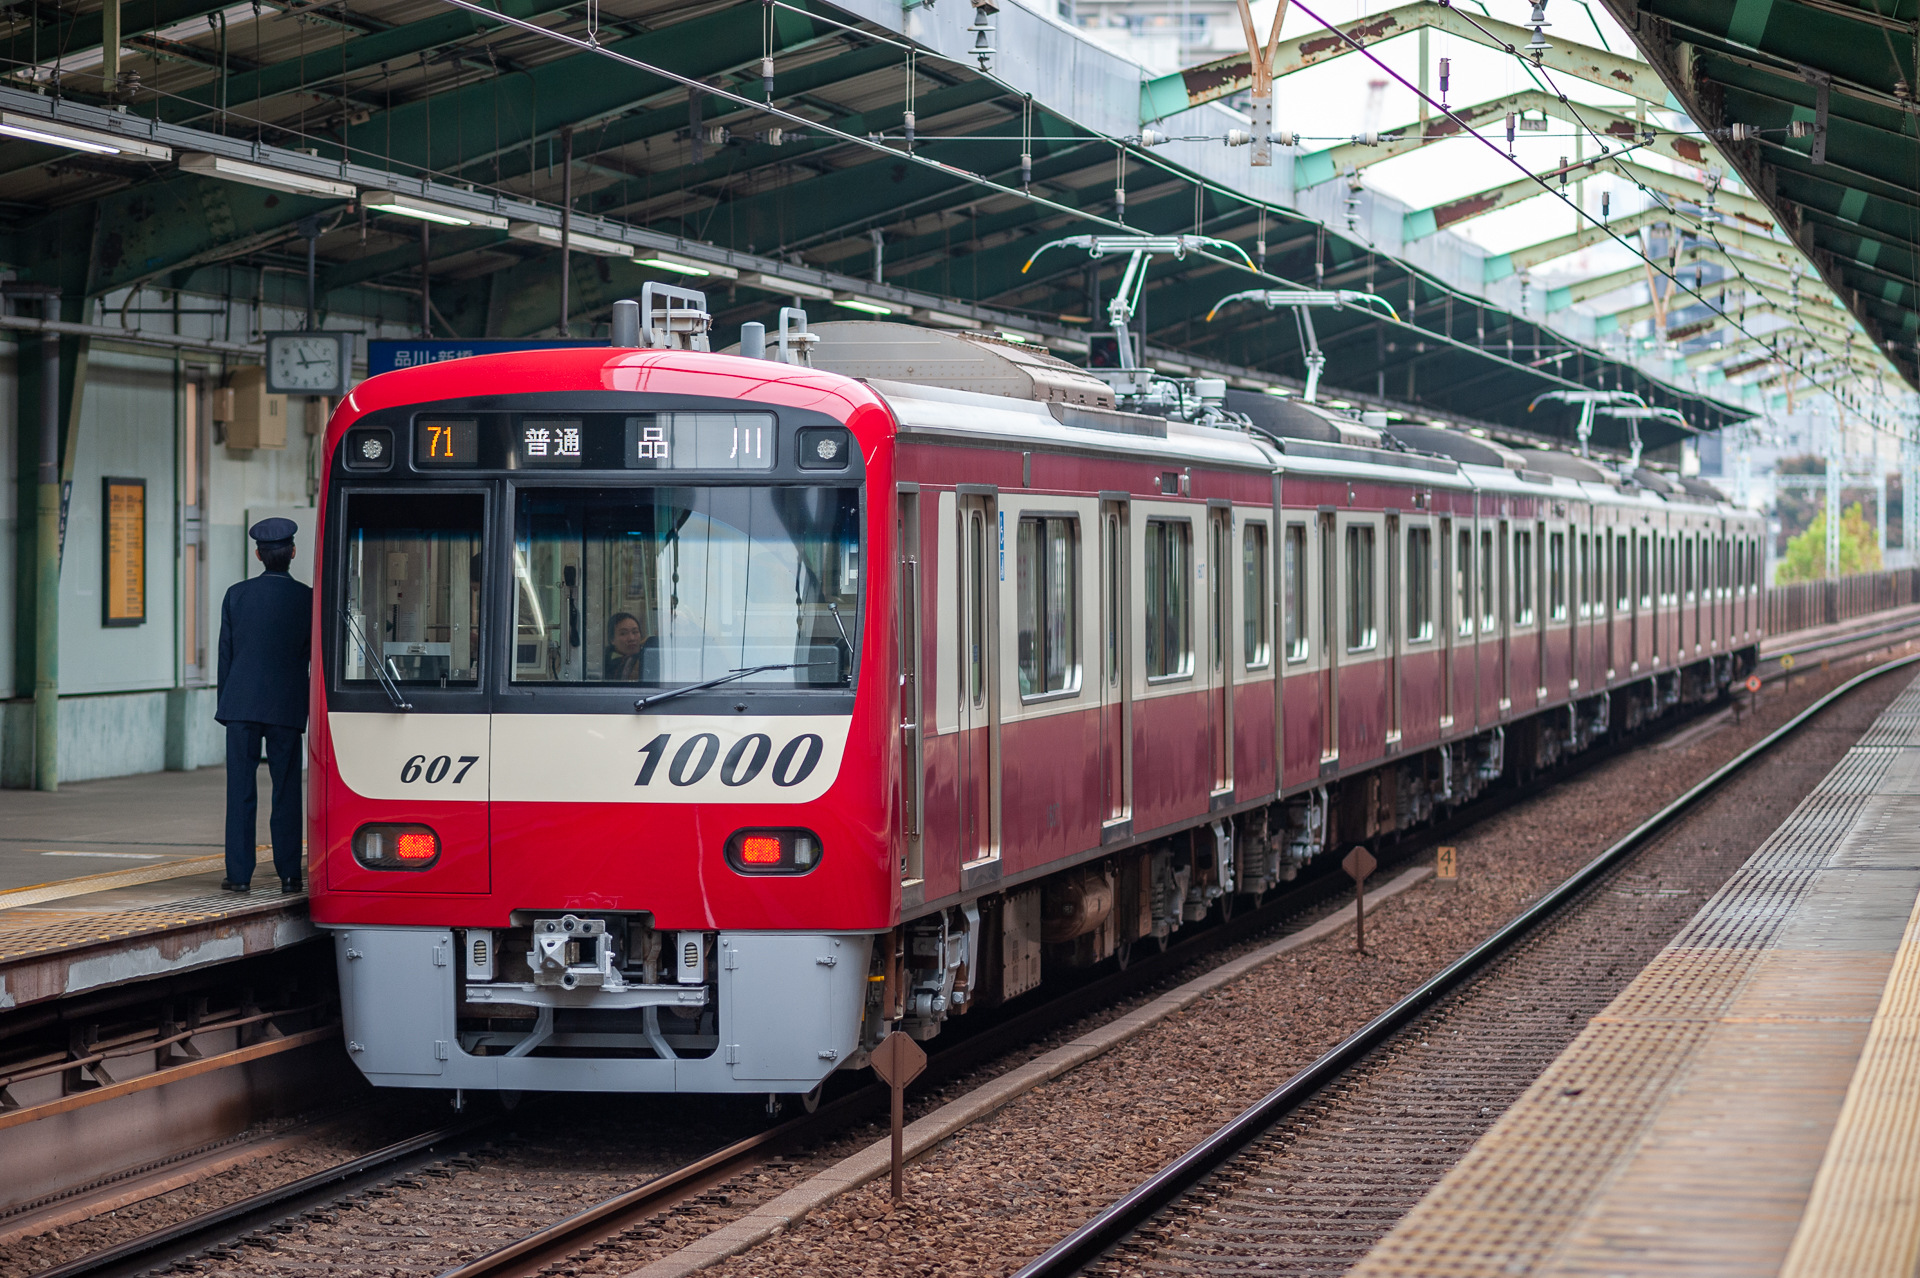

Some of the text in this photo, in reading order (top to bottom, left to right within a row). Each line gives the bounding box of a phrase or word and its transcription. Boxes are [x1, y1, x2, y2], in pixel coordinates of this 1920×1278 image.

[427, 426, 454, 457] 71
[524, 427, 581, 456] 普通
[400, 754, 480, 785] 607
[634, 733, 824, 788] 1000
[1440, 849, 1453, 865] 4
